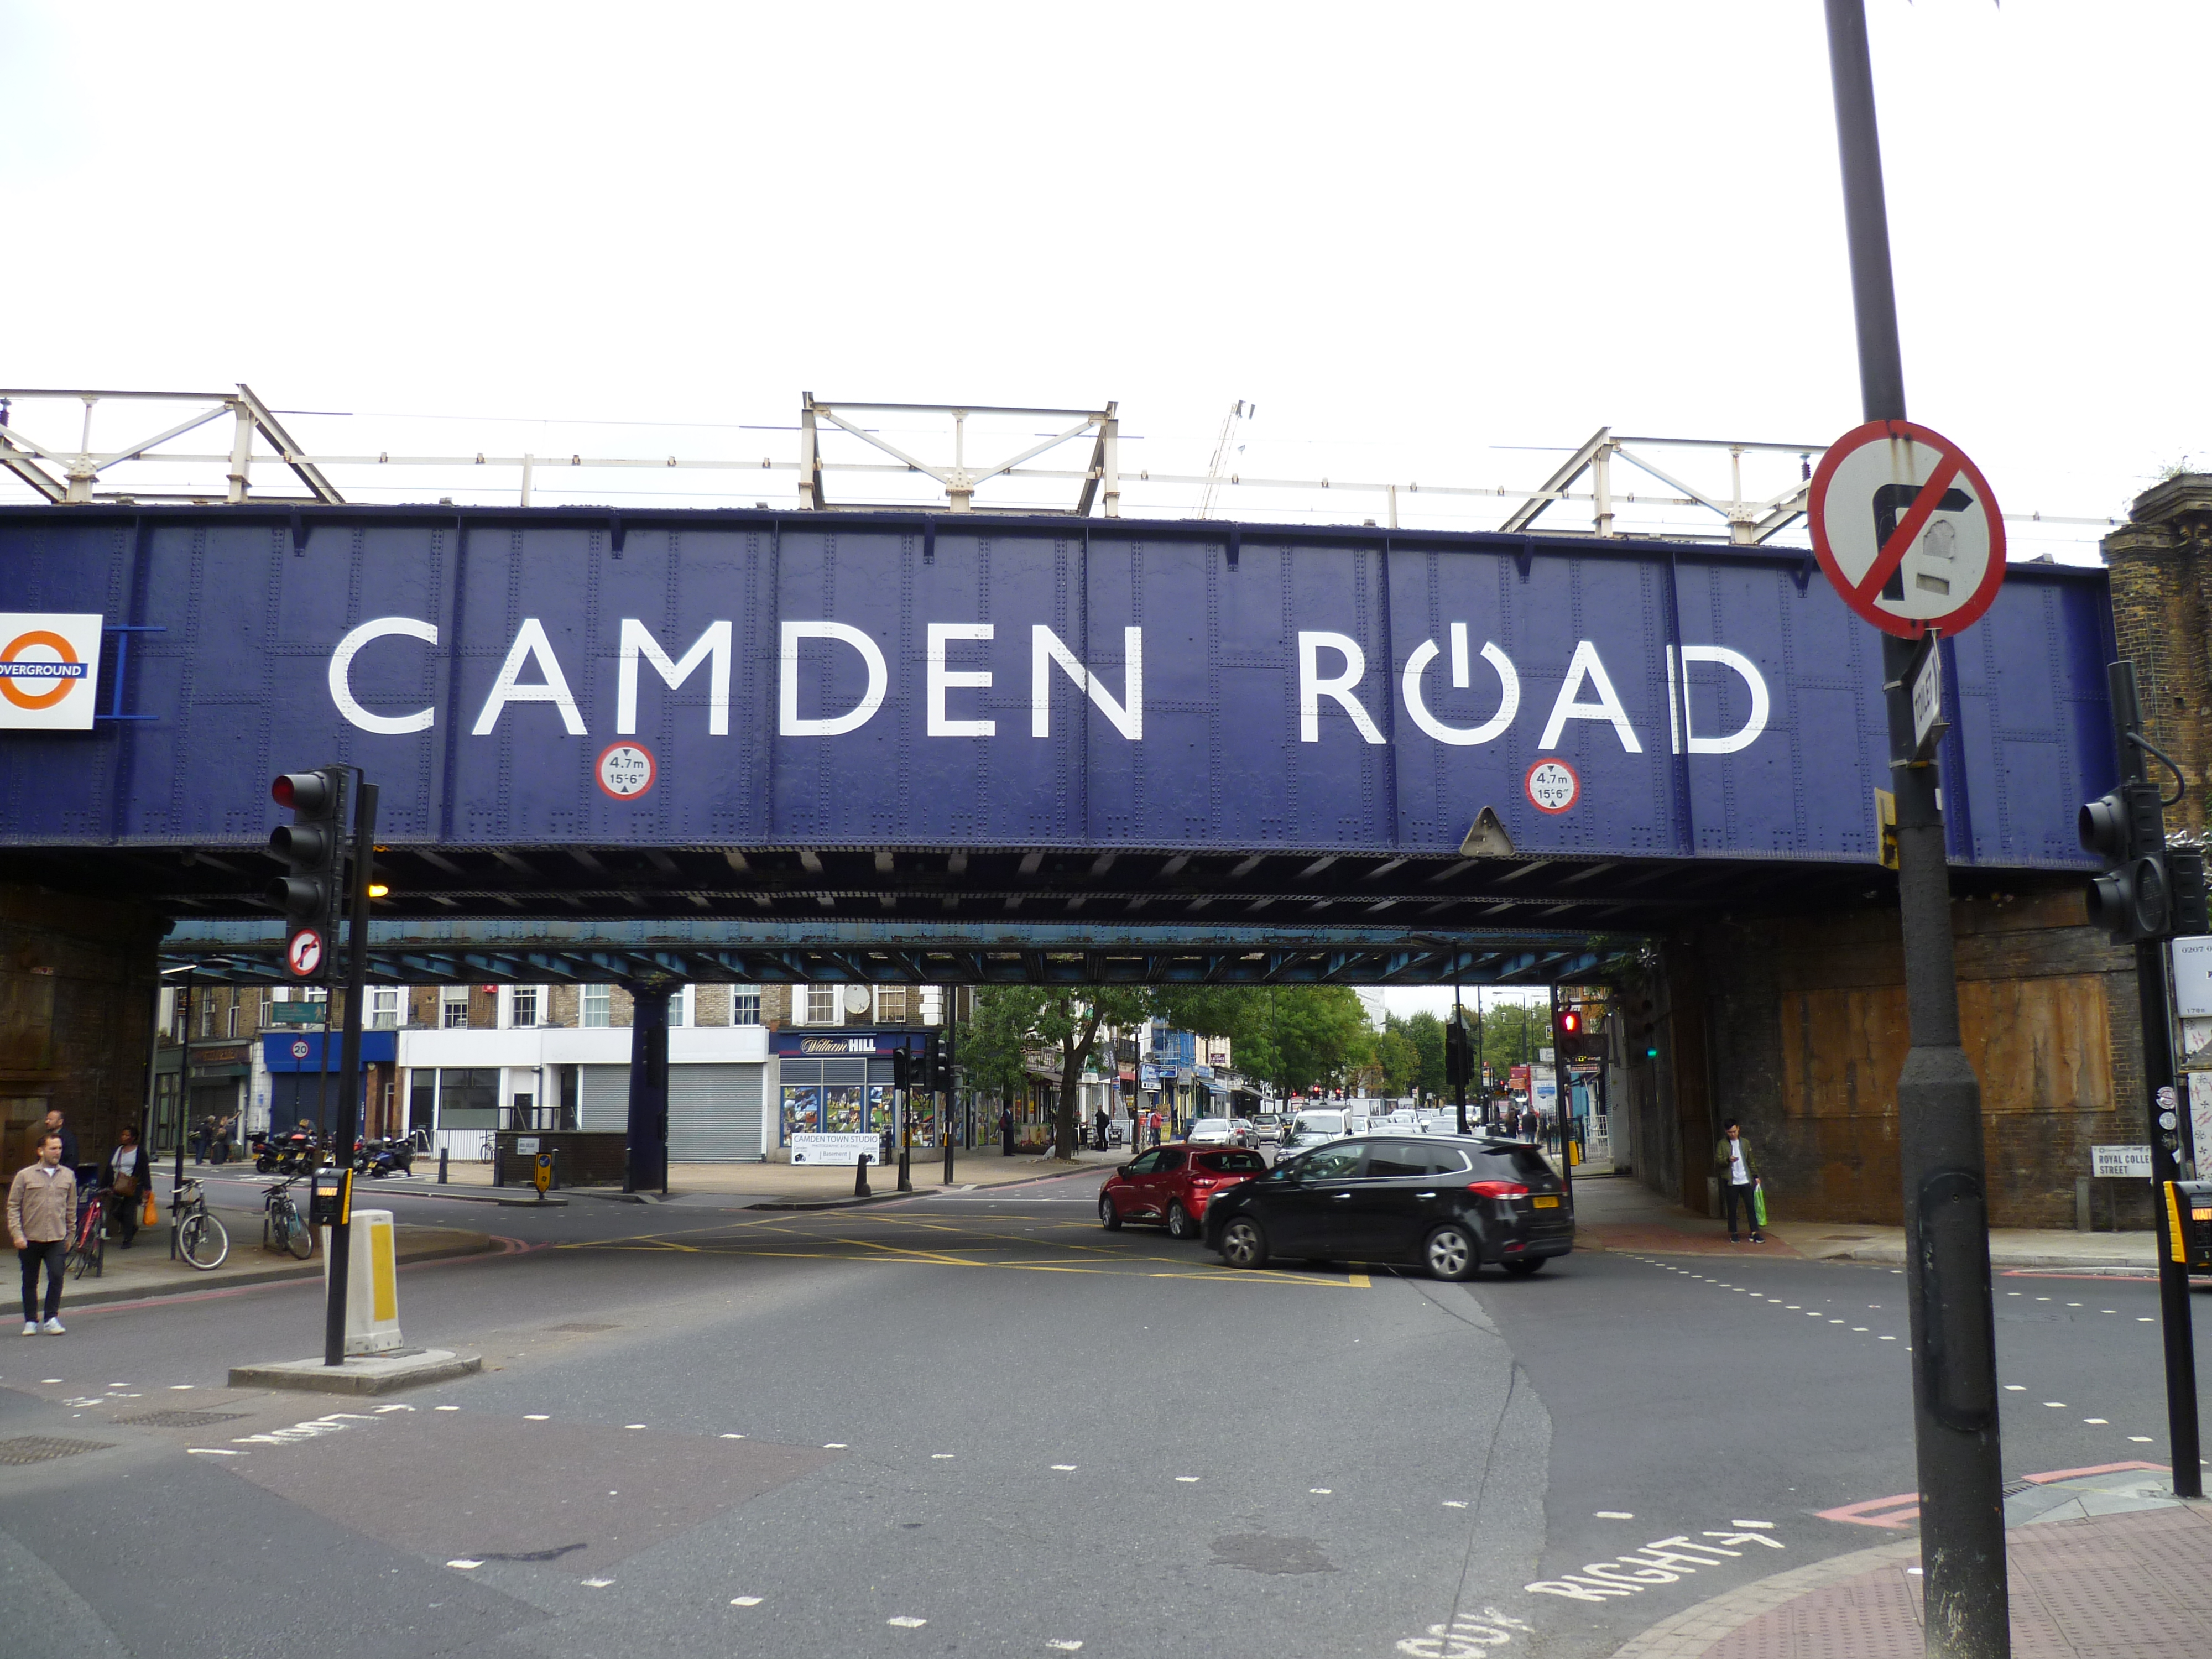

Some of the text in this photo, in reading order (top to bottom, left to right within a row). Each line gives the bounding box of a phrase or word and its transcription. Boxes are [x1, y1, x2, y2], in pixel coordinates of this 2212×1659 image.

[328, 617, 1770, 754] CAMDEN ROAD
[1915, 669, 1932, 727] TOILET
[294, 1045, 307, 1053] 20
[801, 1037, 876, 1052] William HILL
[2099, 1155, 2122, 1164] ROYAL
[2100, 1166, 2127, 1174] STREET
[317, 1187, 337, 1196] WAIT
[2192, 1209, 2212, 1220] WAIT
[1524, 1536, 1742, 1601] RIGHT
